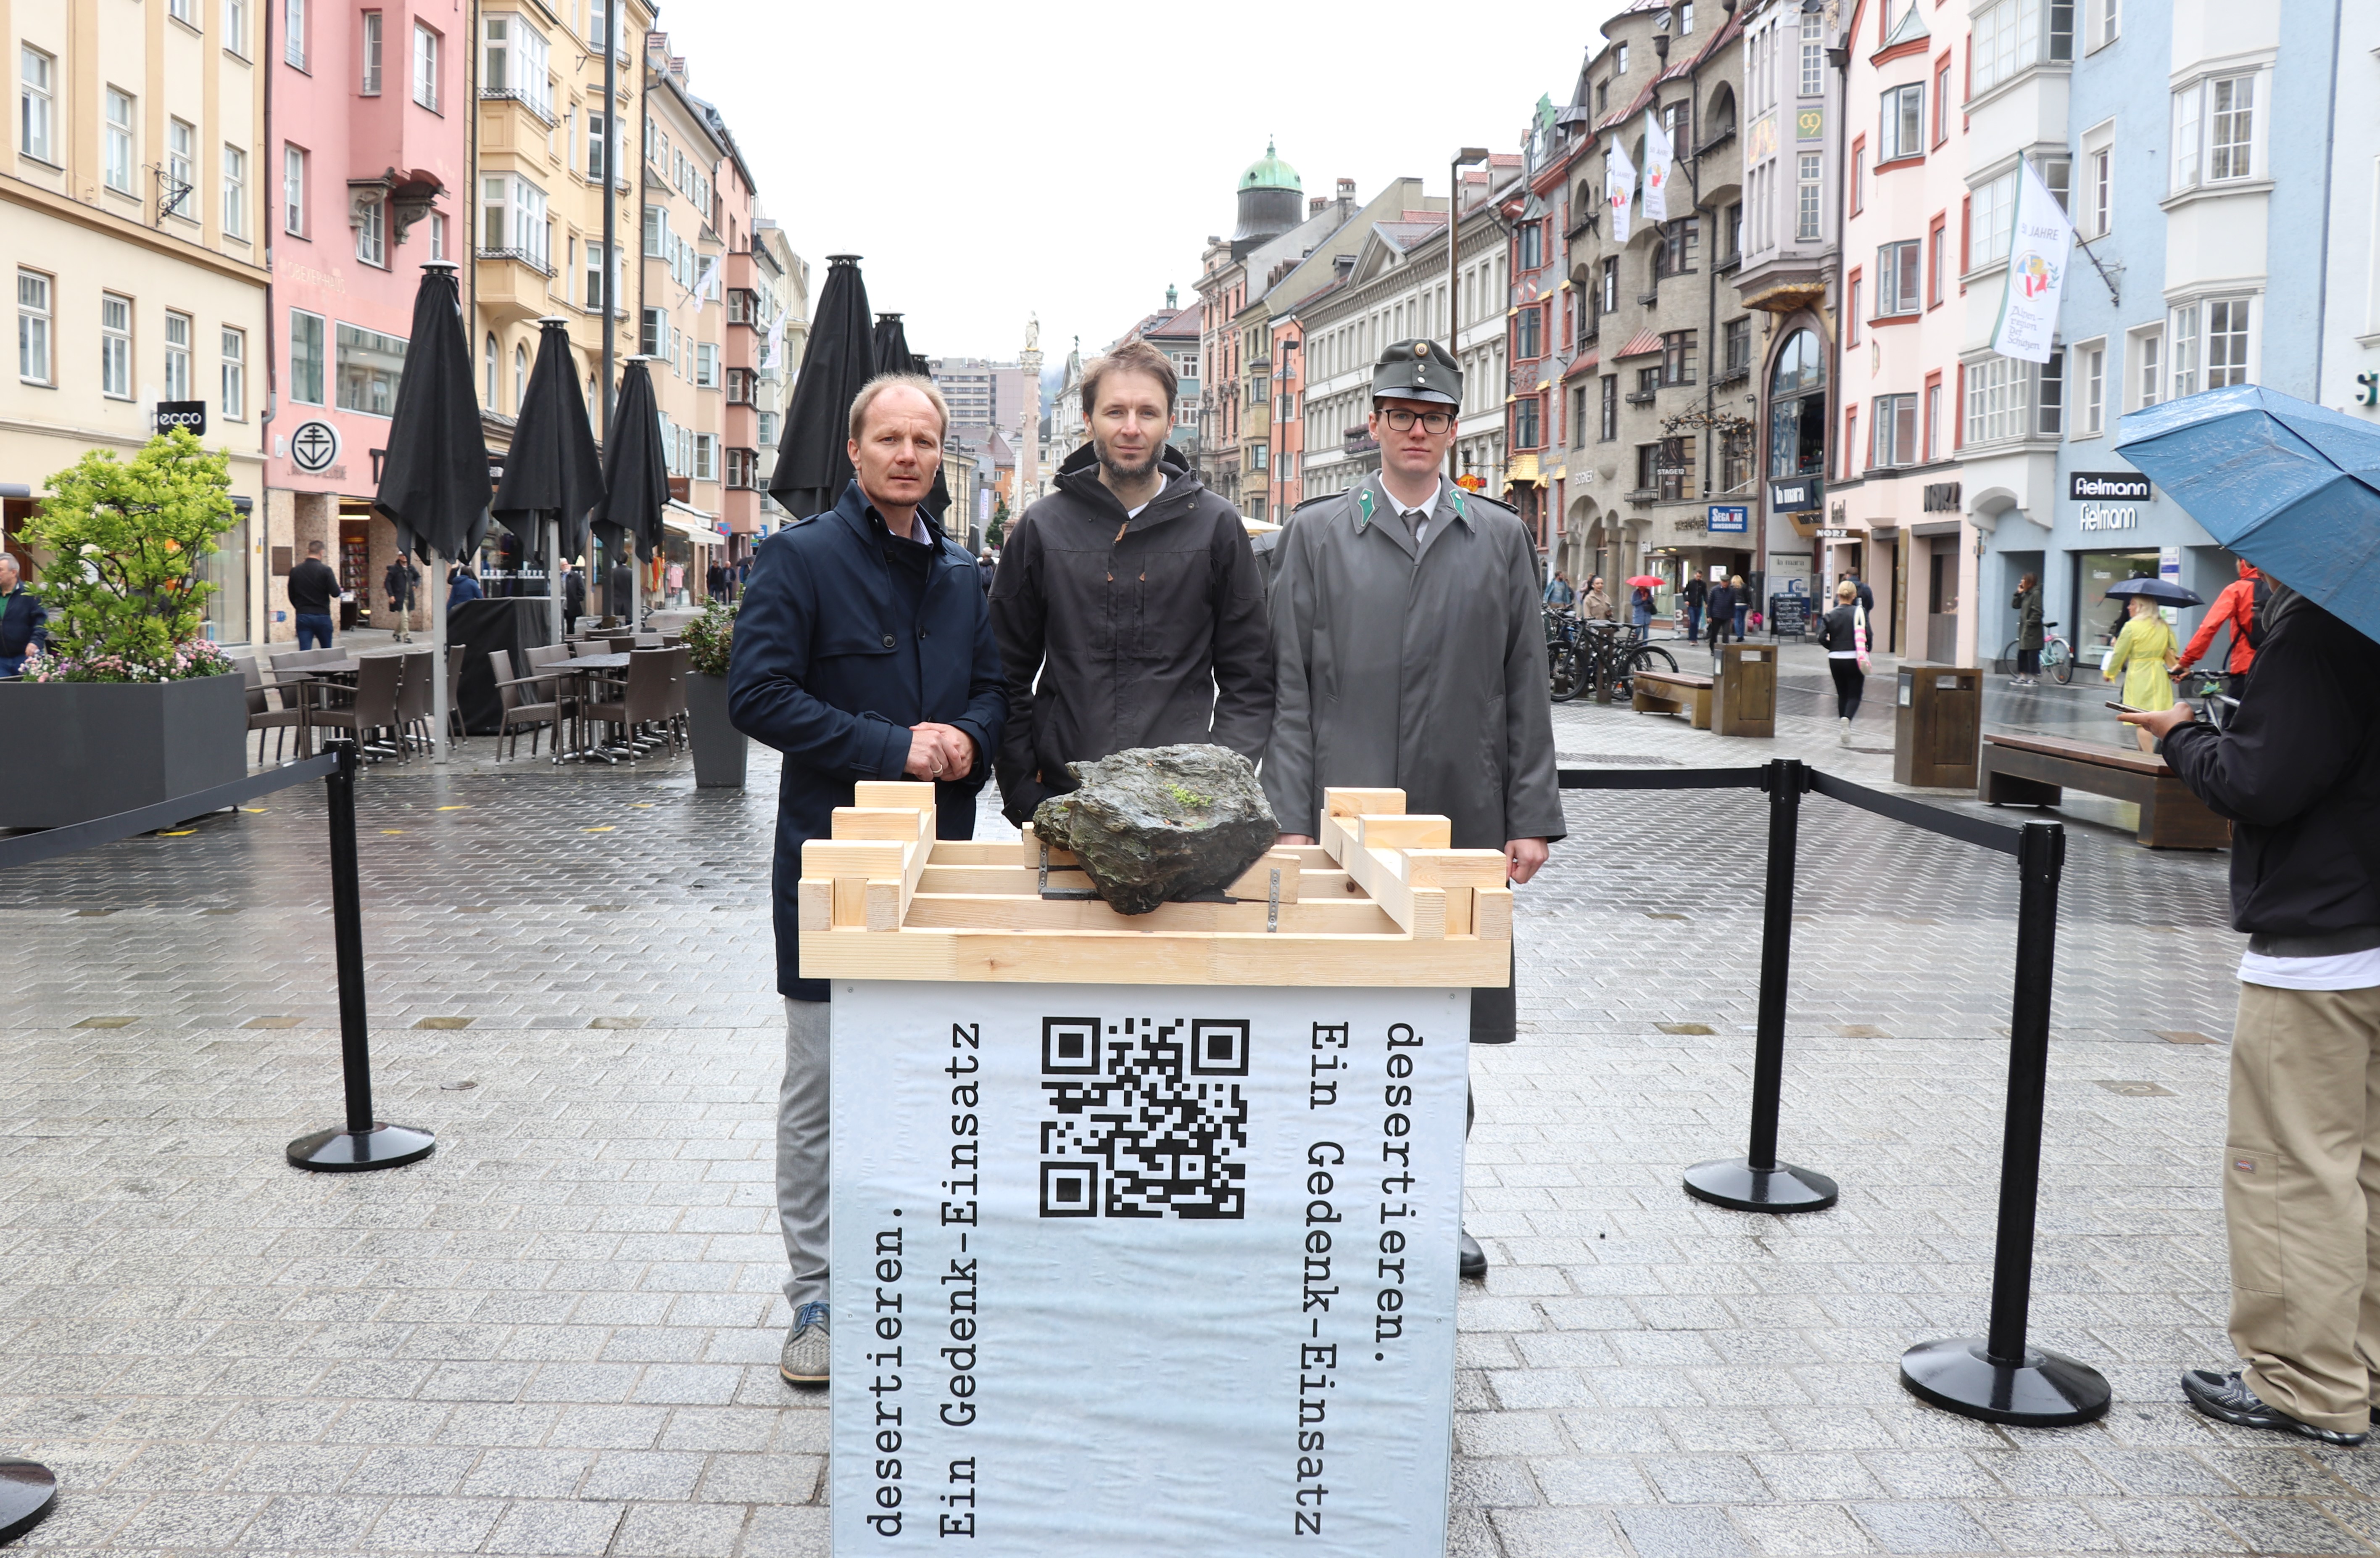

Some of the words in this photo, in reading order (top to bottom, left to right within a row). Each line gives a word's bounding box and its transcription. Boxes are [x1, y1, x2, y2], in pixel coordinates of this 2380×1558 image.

[2028, 226, 2060, 240] JAHRE
[159, 412, 202, 425] ecco
[1784, 487, 1805, 503] mara
[2076, 477, 2148, 496] fielmann
[2080, 502, 2137, 531] fielmann
[1310, 1021, 1349, 1110] Ein
[940, 1023, 979, 1426] Gedenk-Einsatz
[1375, 1023, 1423, 1361] desertieren.
[867, 1208, 902, 1537] desertieren.
[1295, 1141, 1344, 1535] Gedenk-Einsatz
[940, 1457, 975, 1538] Ein
